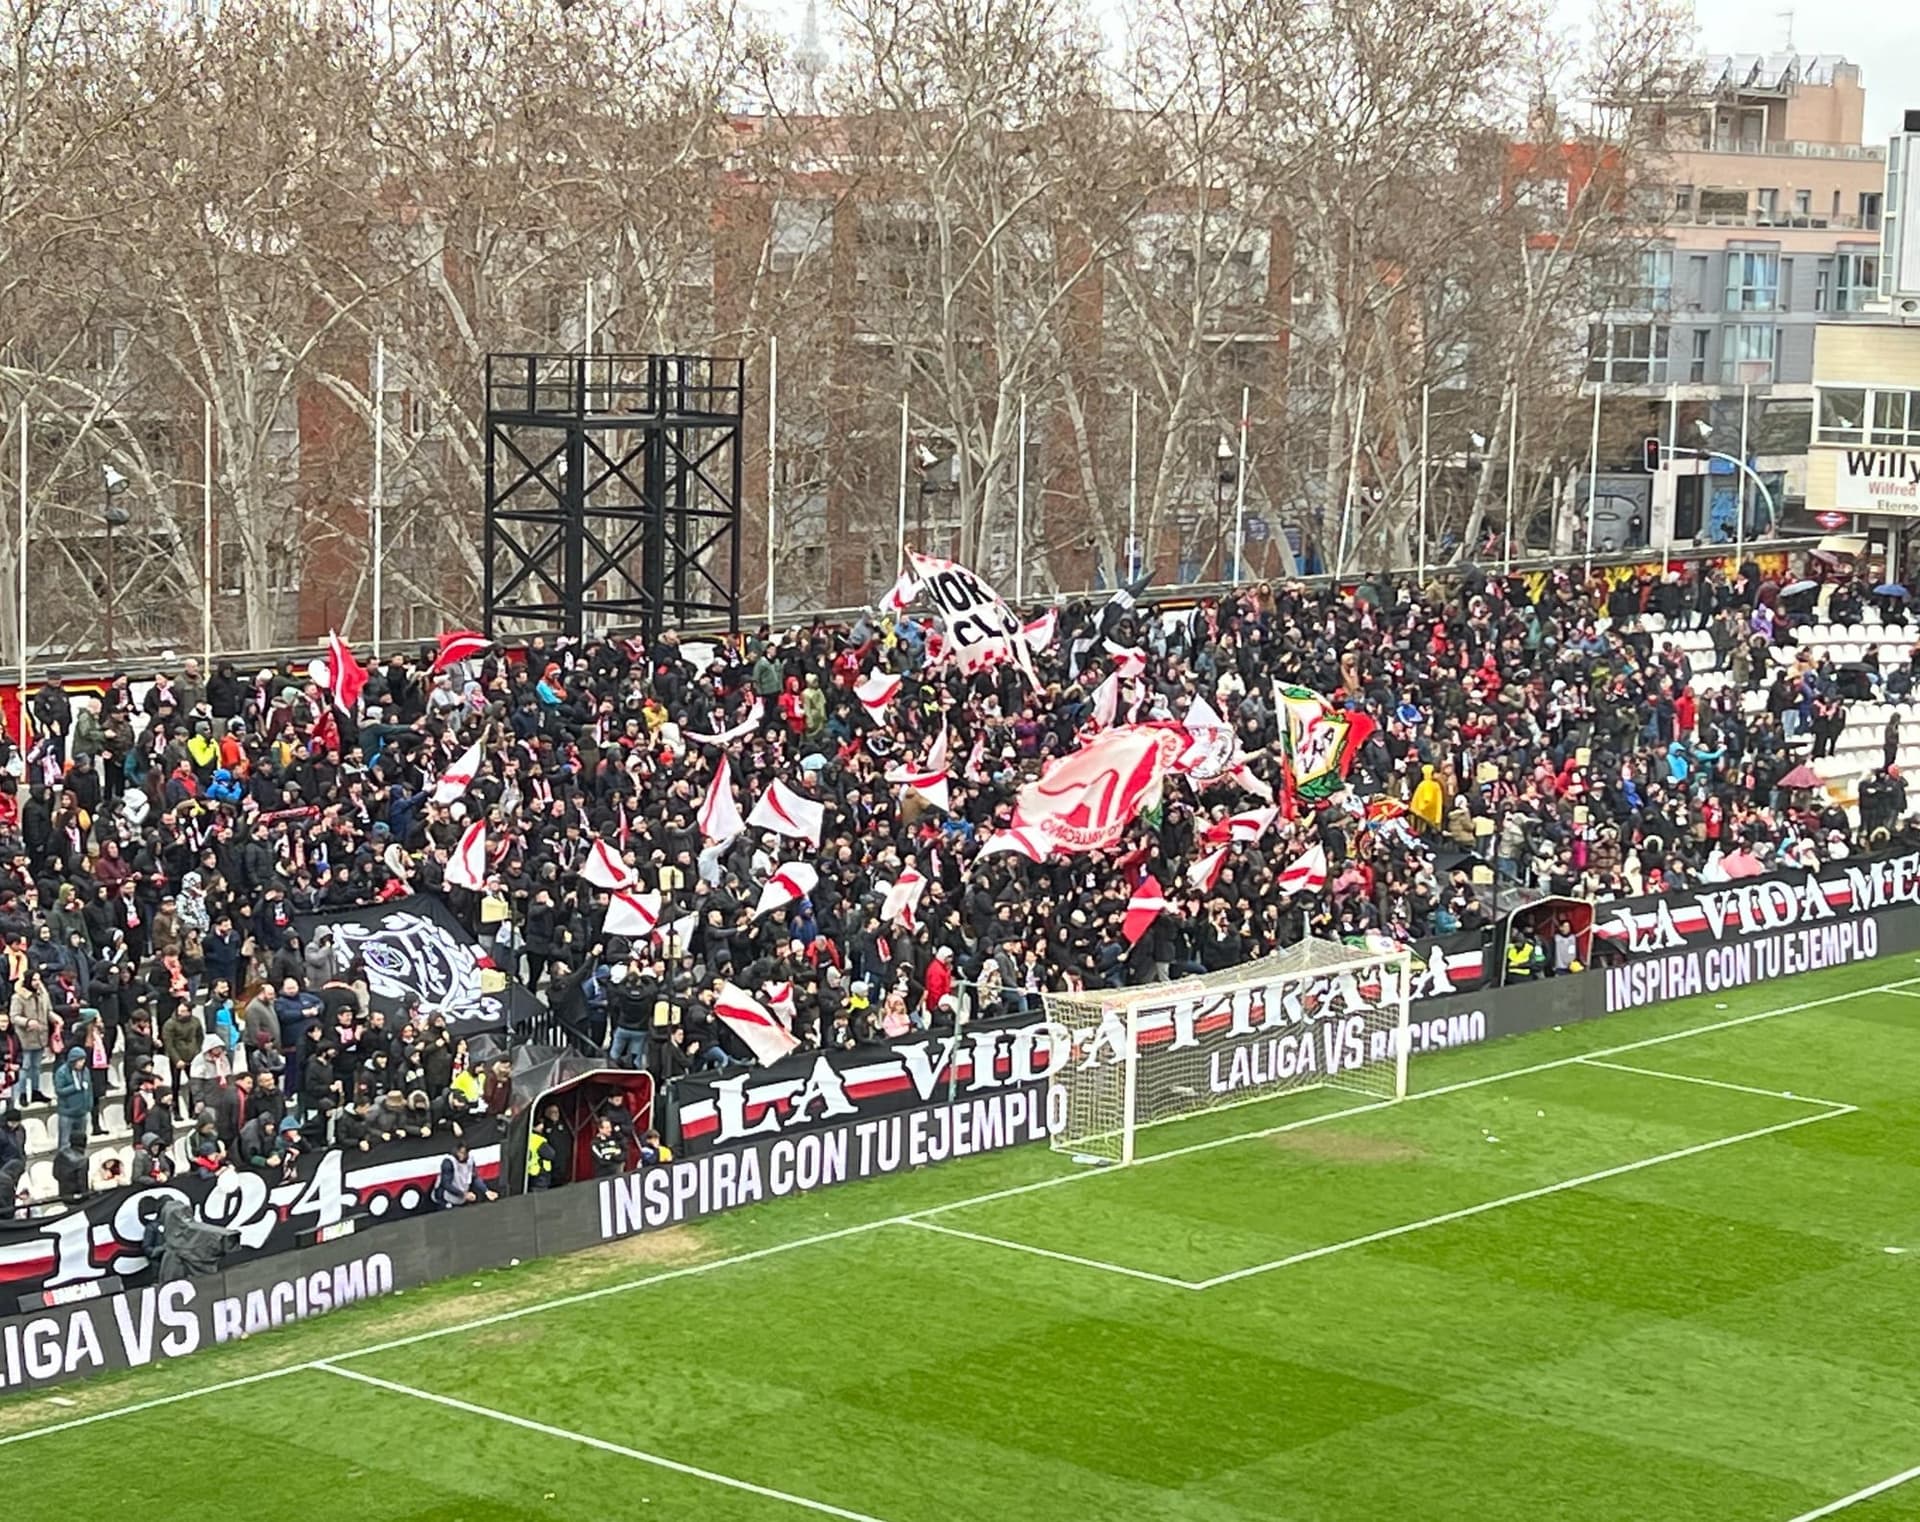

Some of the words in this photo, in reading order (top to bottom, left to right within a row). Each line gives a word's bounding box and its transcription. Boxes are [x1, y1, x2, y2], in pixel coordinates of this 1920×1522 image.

[1847, 451, 1920, 485] Willy
[1869, 481, 1917, 496] Wilfred
[1612, 899, 1687, 954] LA
[1695, 873, 1836, 940] VIDA
[1843, 851, 1920, 913] ME
[1605, 952, 1702, 1013] INSPIRA
[1704, 944, 1751, 992] CON
[1753, 936, 1781, 981] TU
[1783, 917, 1879, 974] EJEMPLO
[709, 1055, 858, 1145] LA
[891, 1010, 1141, 1101] VIDA
[1209, 1032, 1316, 1093] LALIGA
[1324, 1015, 1365, 1075] VS
[598, 1148, 762, 1239] INSPIRA
[770, 1128, 848, 1196] CON
[856, 1116, 901, 1175] TU
[908, 1083, 1068, 1166] EJEMPLO
[0, 1310, 105, 1388] IGA
[112, 1279, 201, 1368] VS
[212, 1253, 393, 1344] RACISMO
